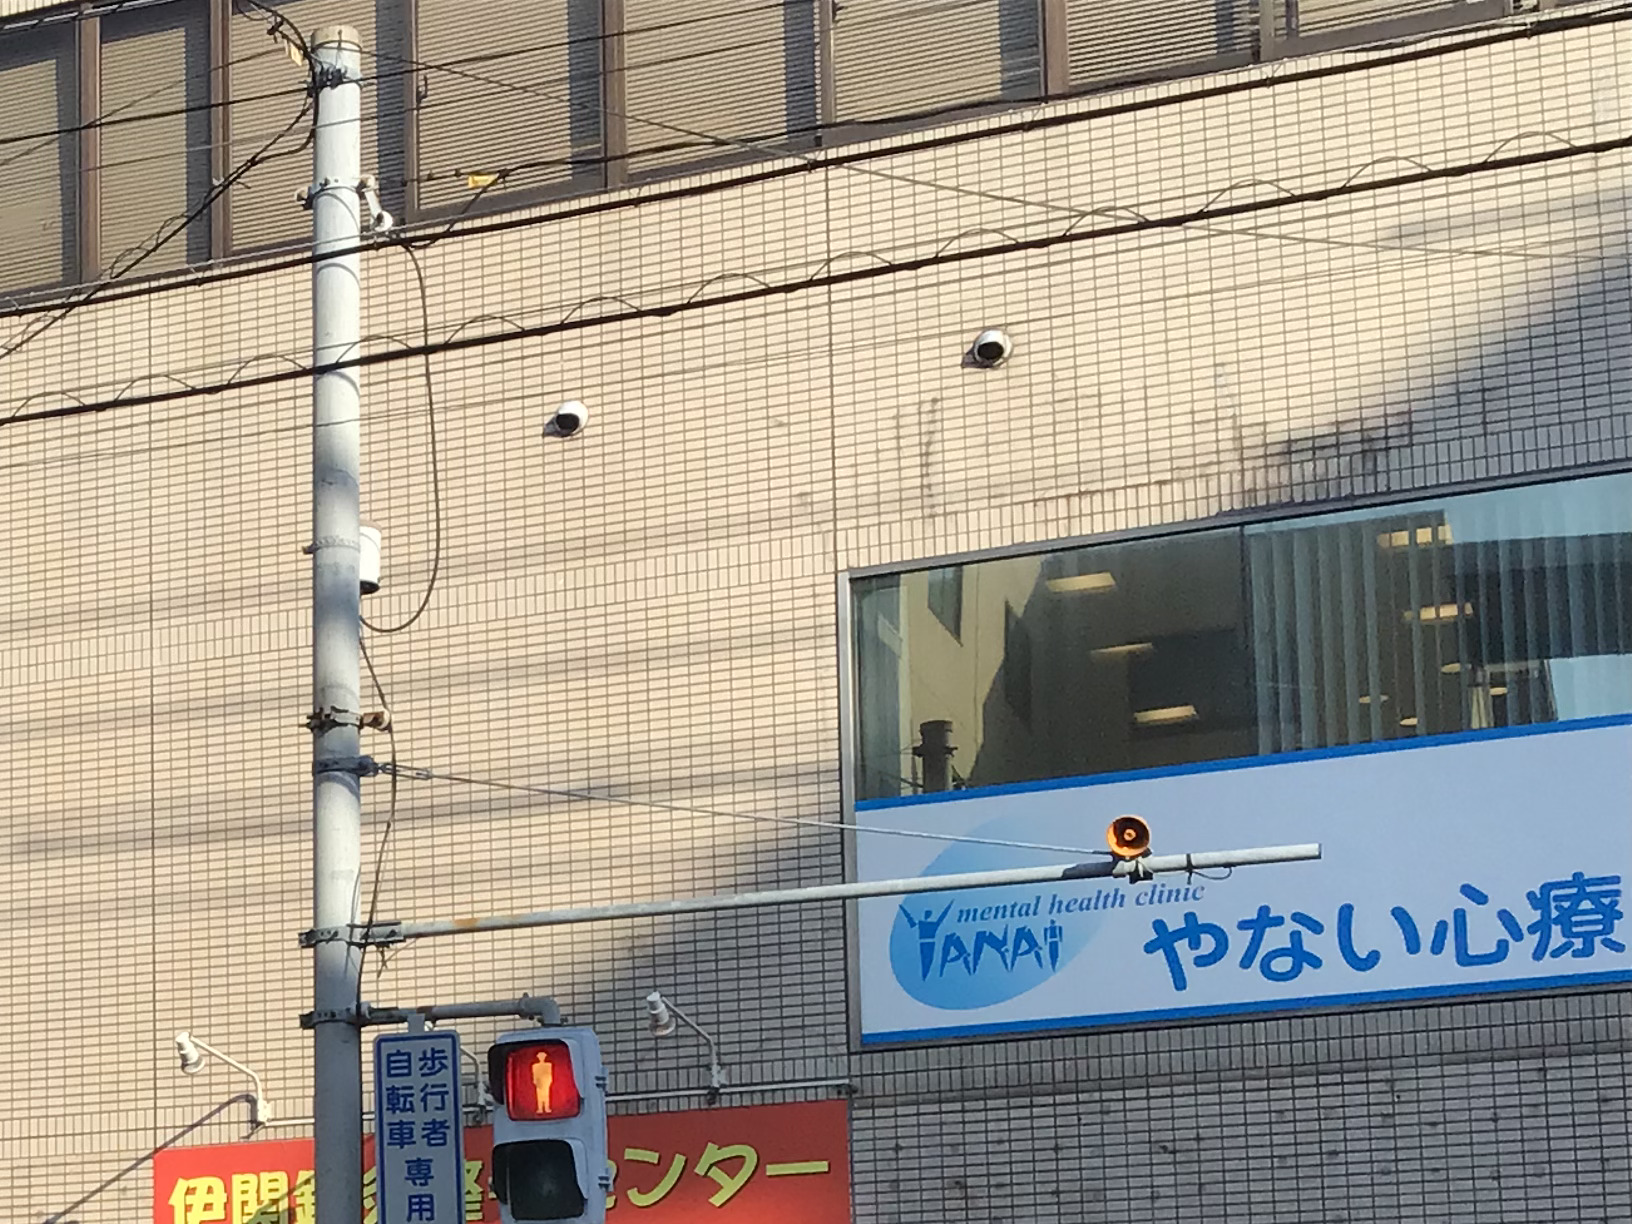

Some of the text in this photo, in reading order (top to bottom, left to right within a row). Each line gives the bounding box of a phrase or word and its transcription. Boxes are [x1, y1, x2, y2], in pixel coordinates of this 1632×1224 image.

[956, 883, 1206, 923] mental health clinic
[1143, 871, 1627, 992] やない心療
[386, 1050, 416, 1149] 自転車
[418, 1047, 451, 1147] 歩行者
[404, 1157, 436, 1222] 専用
